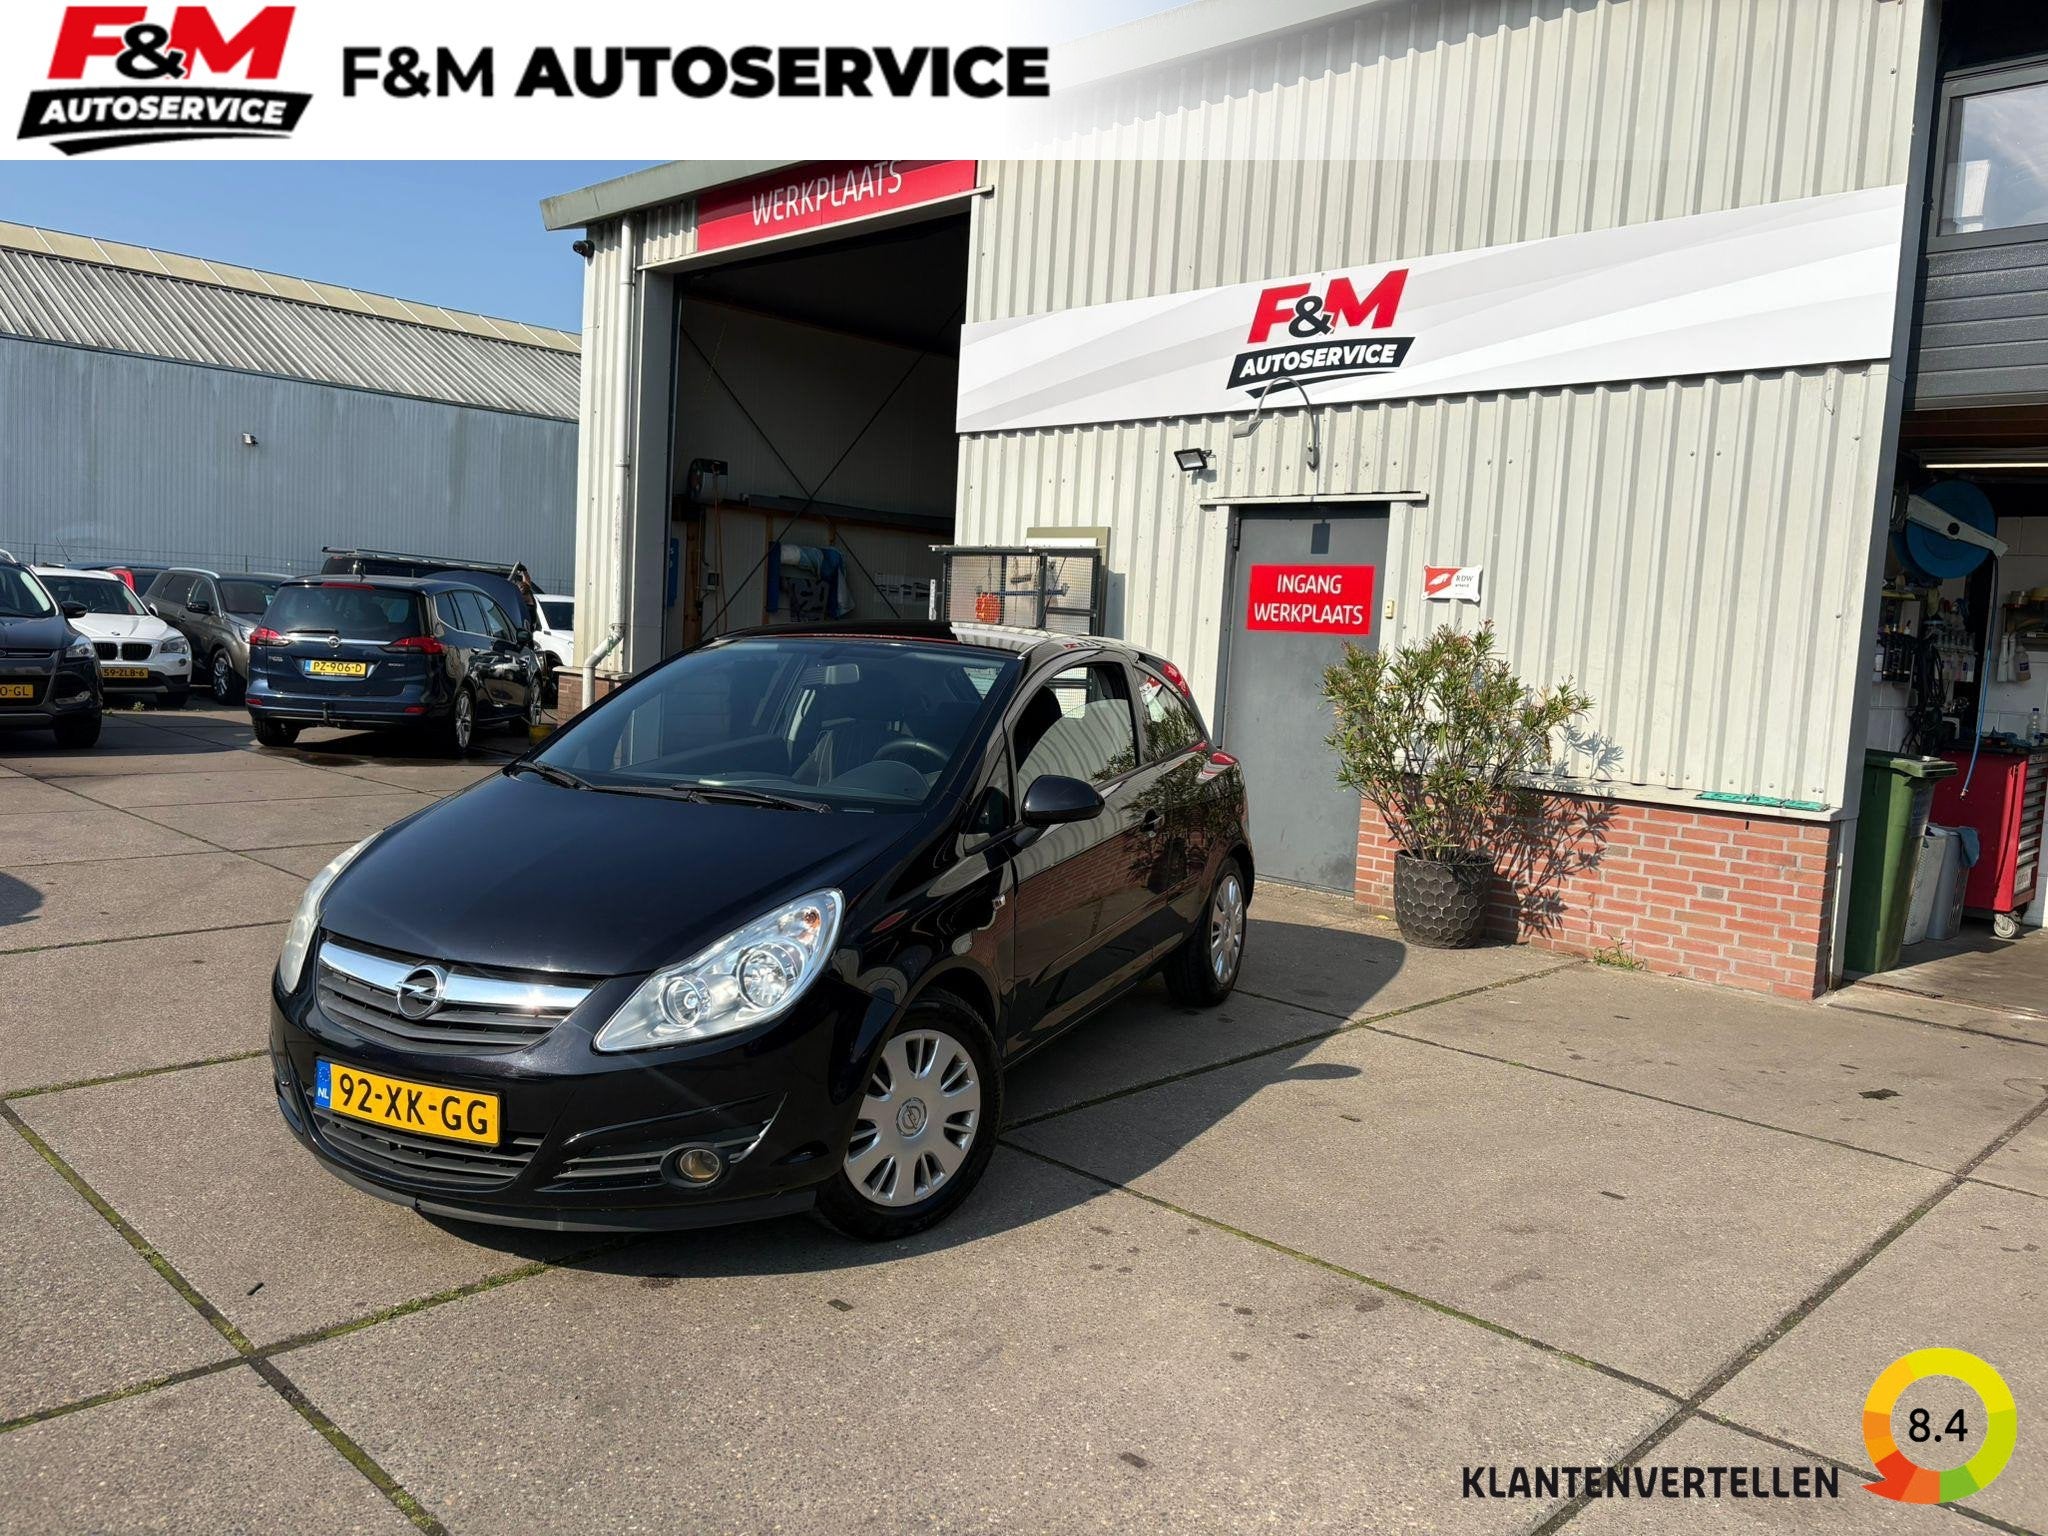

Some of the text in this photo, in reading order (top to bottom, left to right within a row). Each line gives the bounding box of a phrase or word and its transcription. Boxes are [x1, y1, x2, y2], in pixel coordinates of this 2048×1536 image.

[752, 160, 902, 226] WERKPLAATS
[1247, 268, 1409, 344] F&M
[1239, 344, 1398, 379] AUTOSERVICE
[1277, 574, 1343, 594] INGANG
[1254, 602, 1364, 625] WERKPLAATS
[103, 668, 145, 677] 59-ZLB-6
[313, 661, 362, 673] PZ-906-D
[317, 1073, 488, 1136] NL 92-XK-GG
